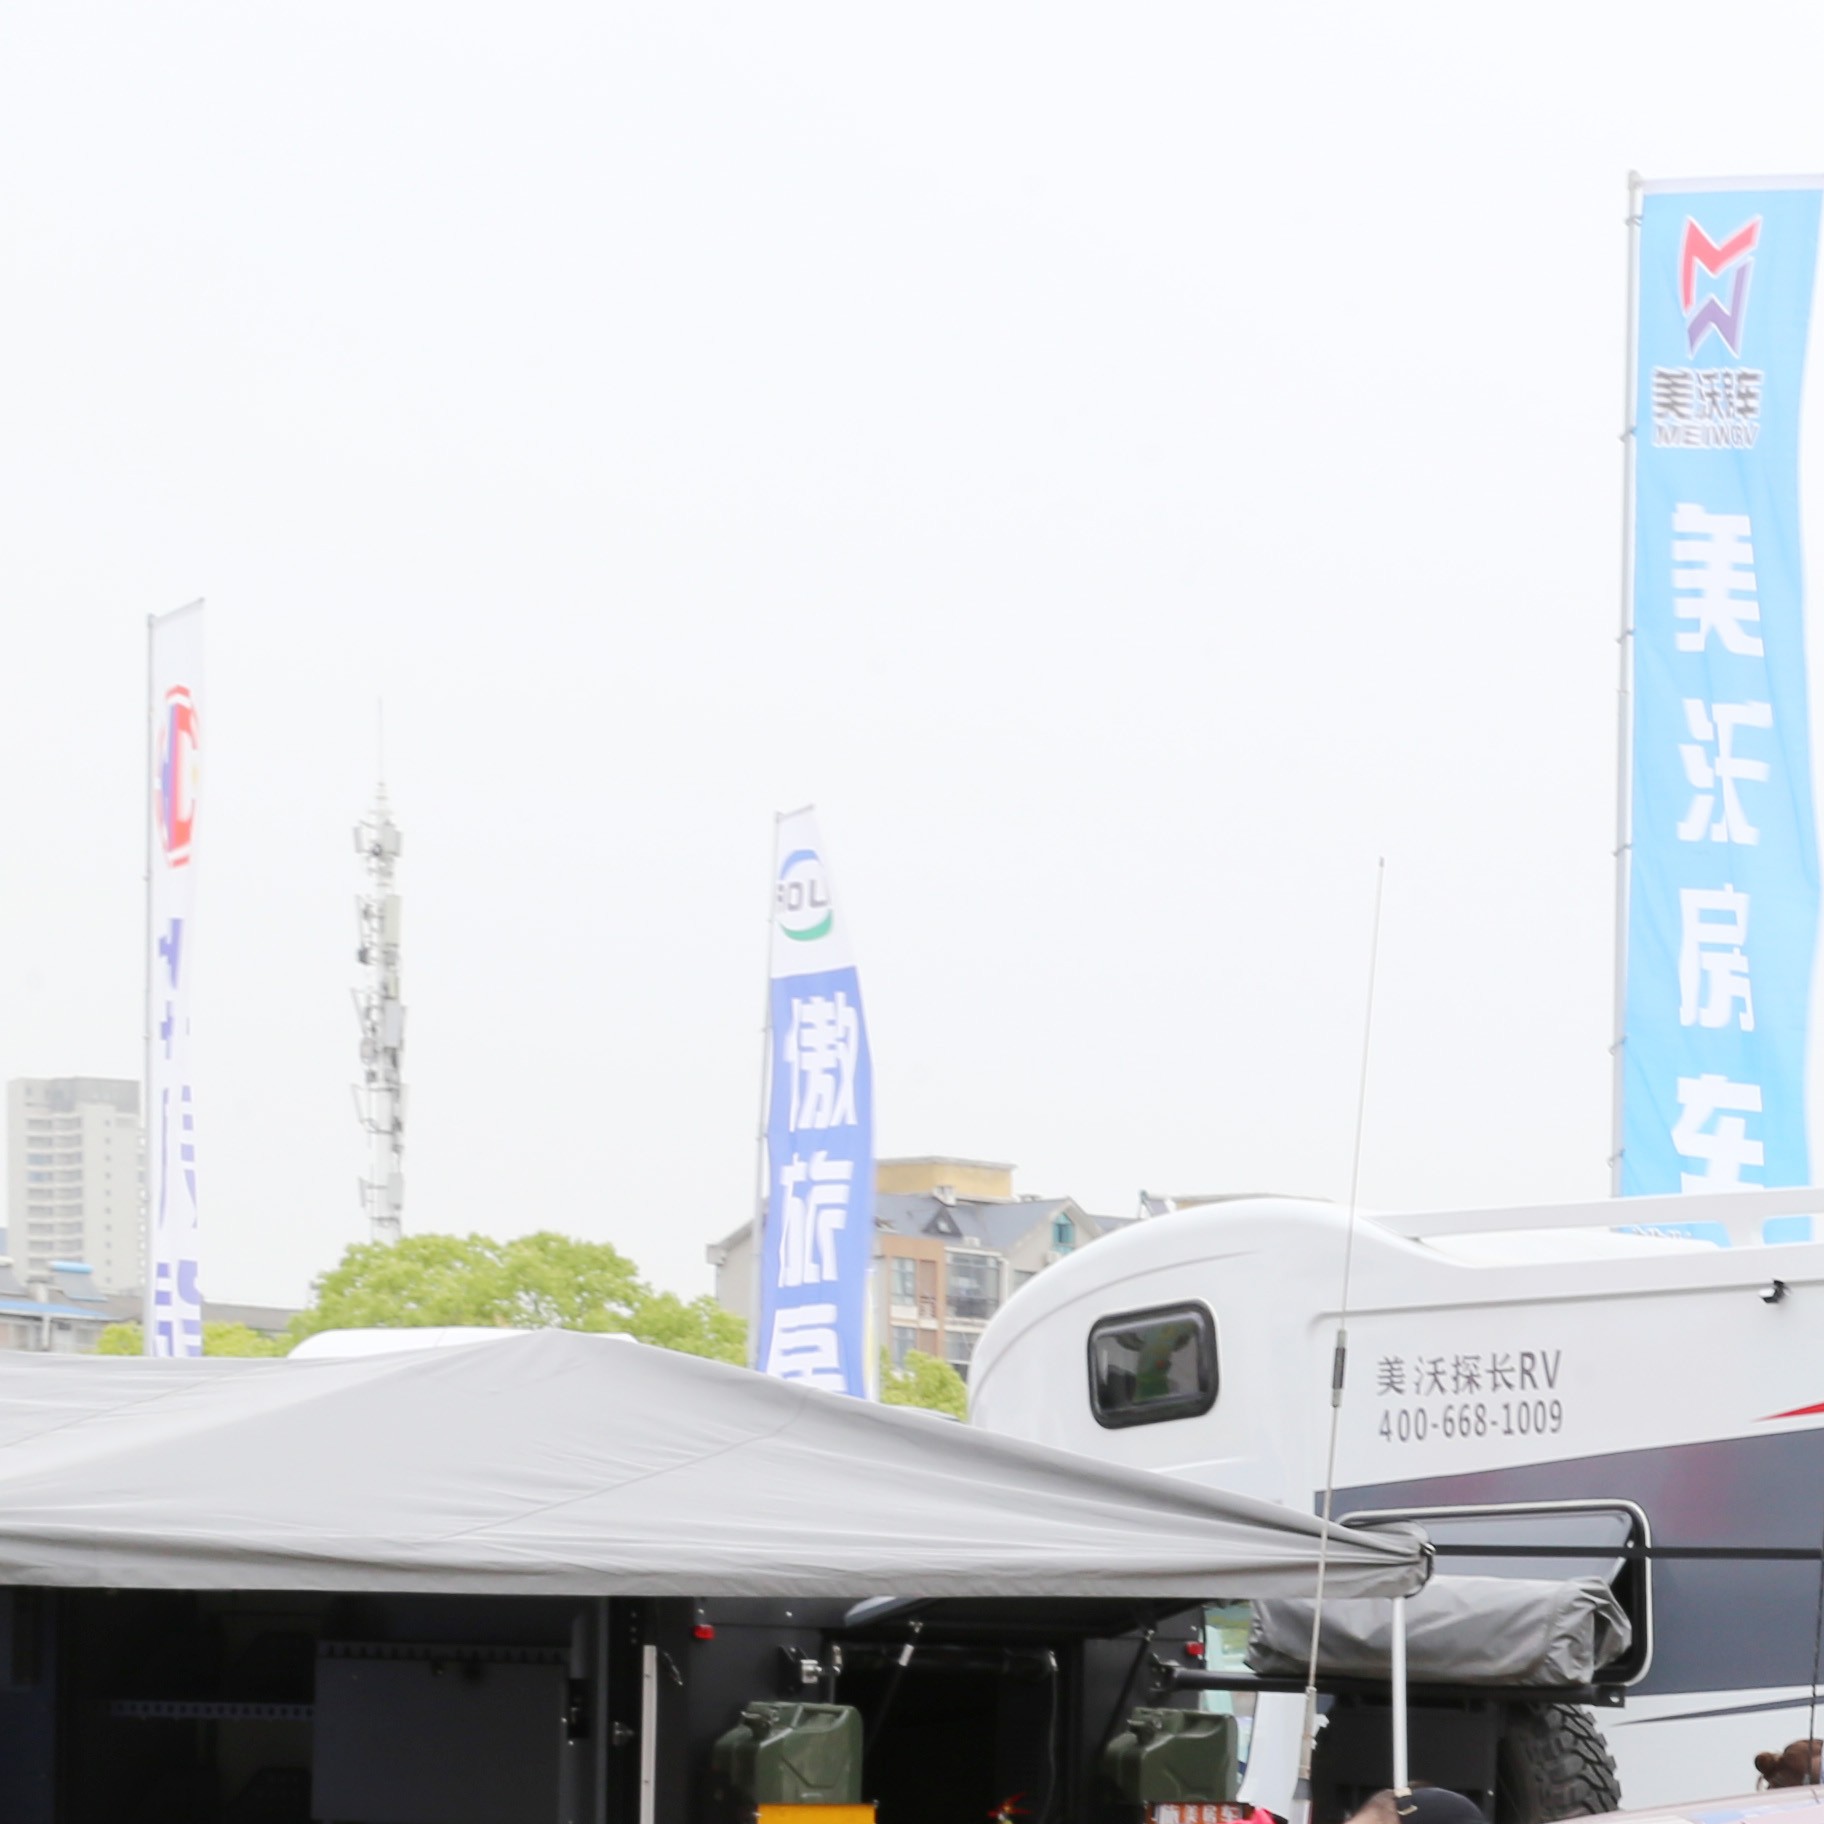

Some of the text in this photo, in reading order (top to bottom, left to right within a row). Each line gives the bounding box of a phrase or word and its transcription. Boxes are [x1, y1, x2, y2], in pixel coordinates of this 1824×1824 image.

[1376, 1350, 1562, 1396] 美沃探长RV
[1378, 1399, 1563, 1443] 400-668-1009
